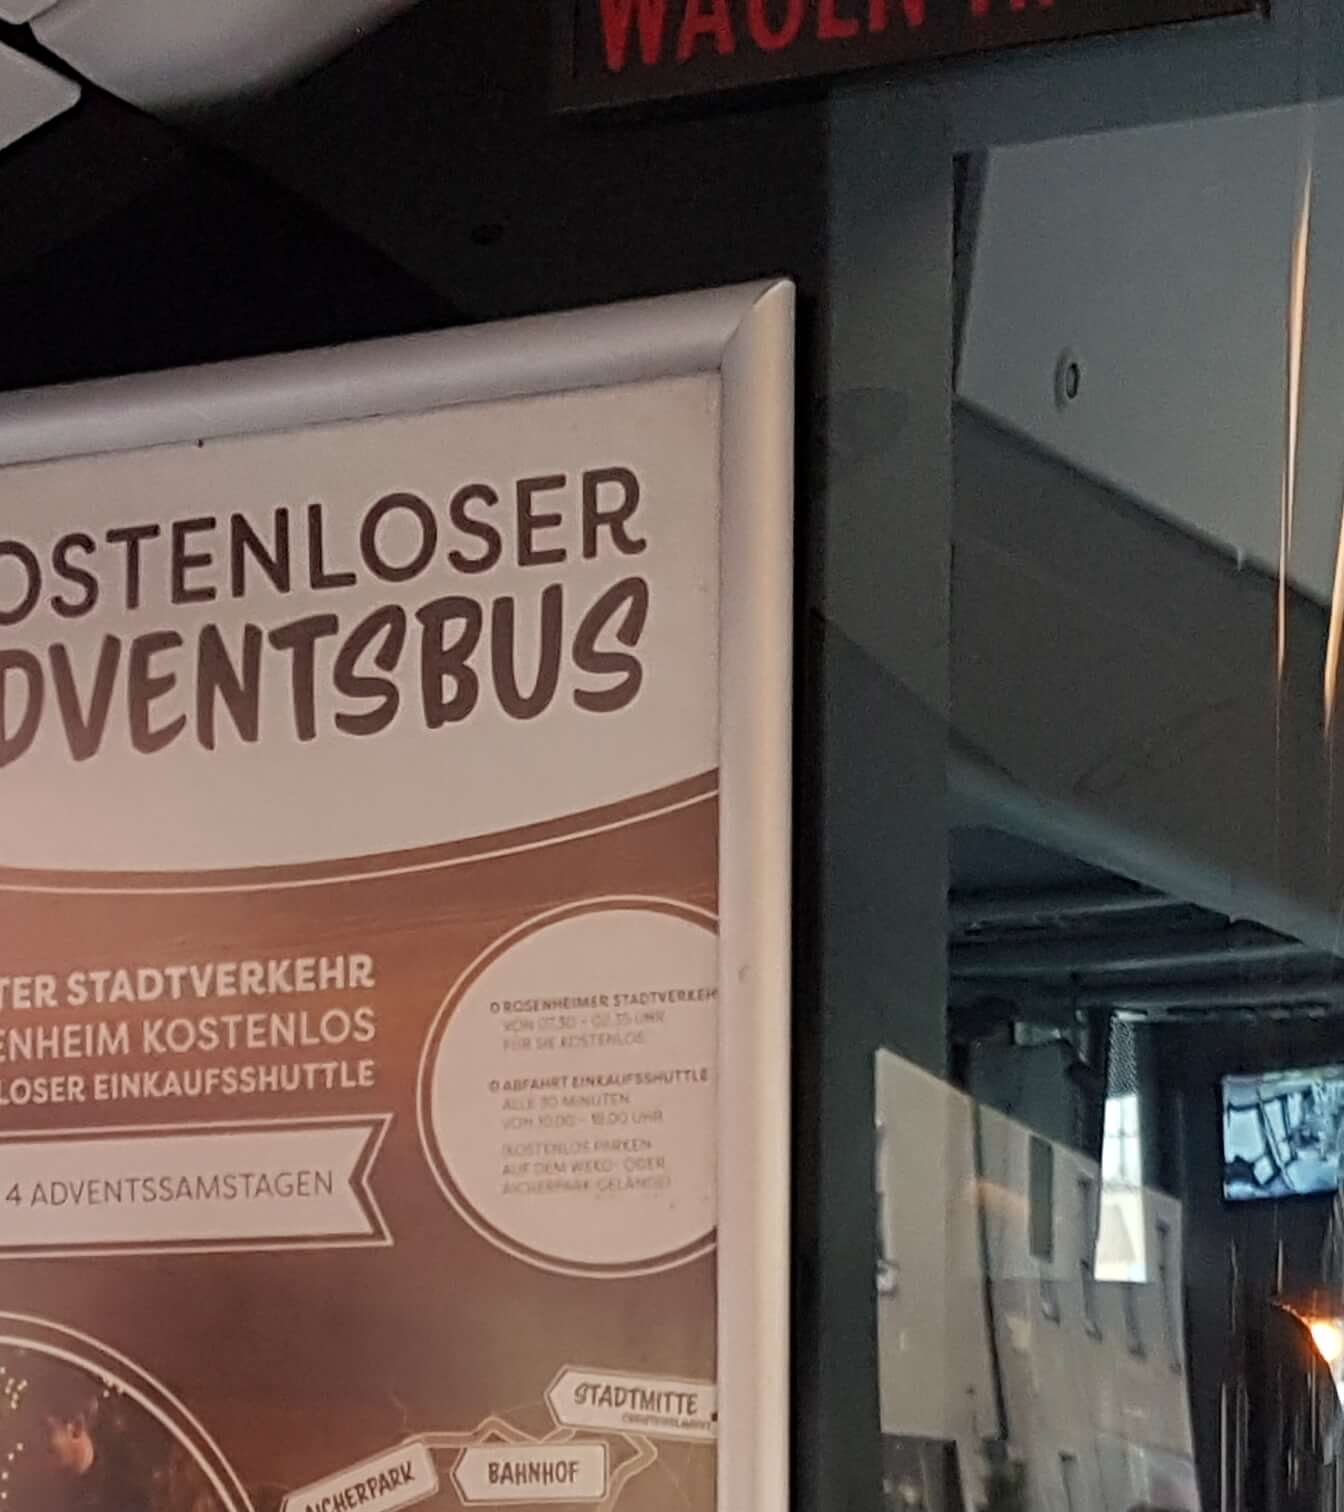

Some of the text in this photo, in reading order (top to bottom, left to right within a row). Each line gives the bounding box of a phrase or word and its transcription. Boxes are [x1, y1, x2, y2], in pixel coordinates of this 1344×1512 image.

[67, 953, 376, 1002] STADTVERKEHR
[143, 1006, 376, 1054] KOSTENLOS
[94, 1058, 376, 1101] EINKAUFSSHUTTLE
[5, 1183, 22, 1206] 4
[30, 1169, 336, 1208] ADVENTSSAMSTAGEN
[574, 1382, 700, 1415] STADTMITTE
[488, 1461, 580, 1485] BAHNHOF
